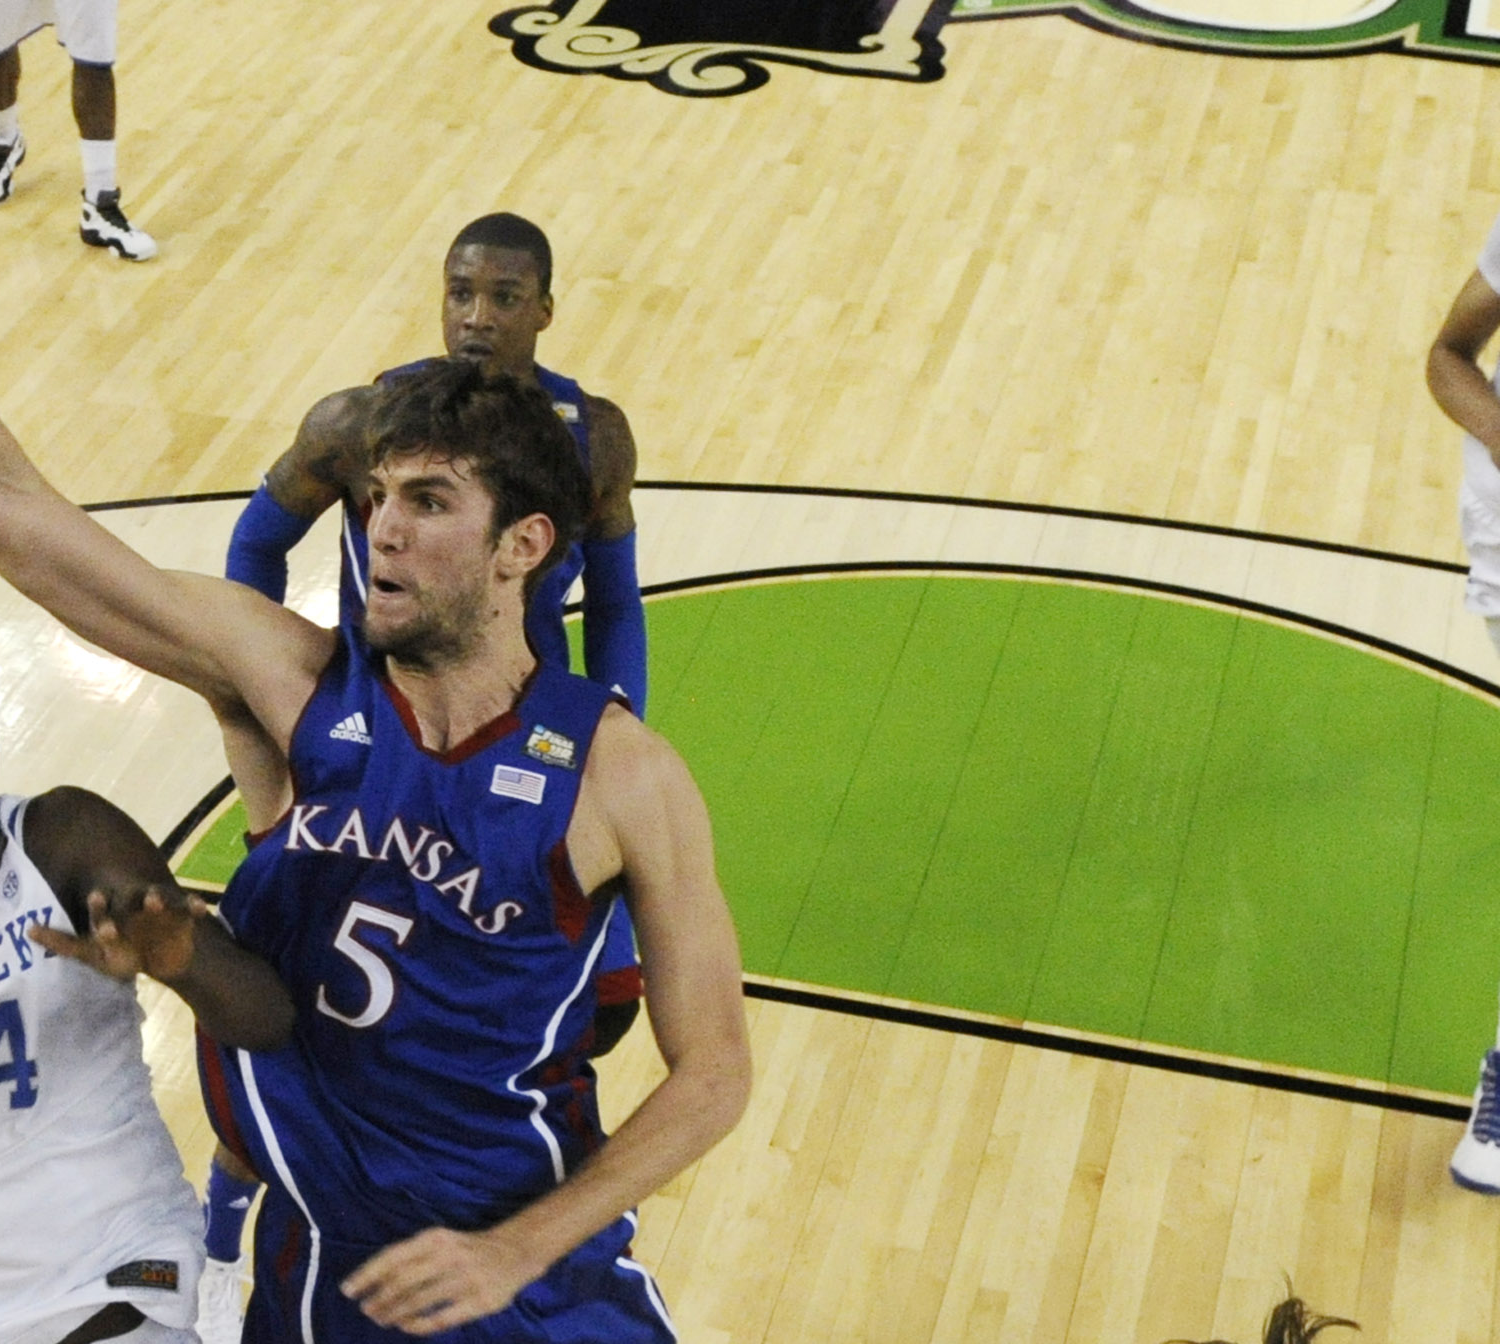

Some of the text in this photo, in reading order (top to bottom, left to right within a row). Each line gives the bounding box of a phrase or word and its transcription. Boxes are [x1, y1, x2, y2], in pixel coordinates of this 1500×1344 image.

[329, 729, 373, 746] adidas
[284, 804, 523, 935] KANSAS
[316, 901, 414, 1028] 5
